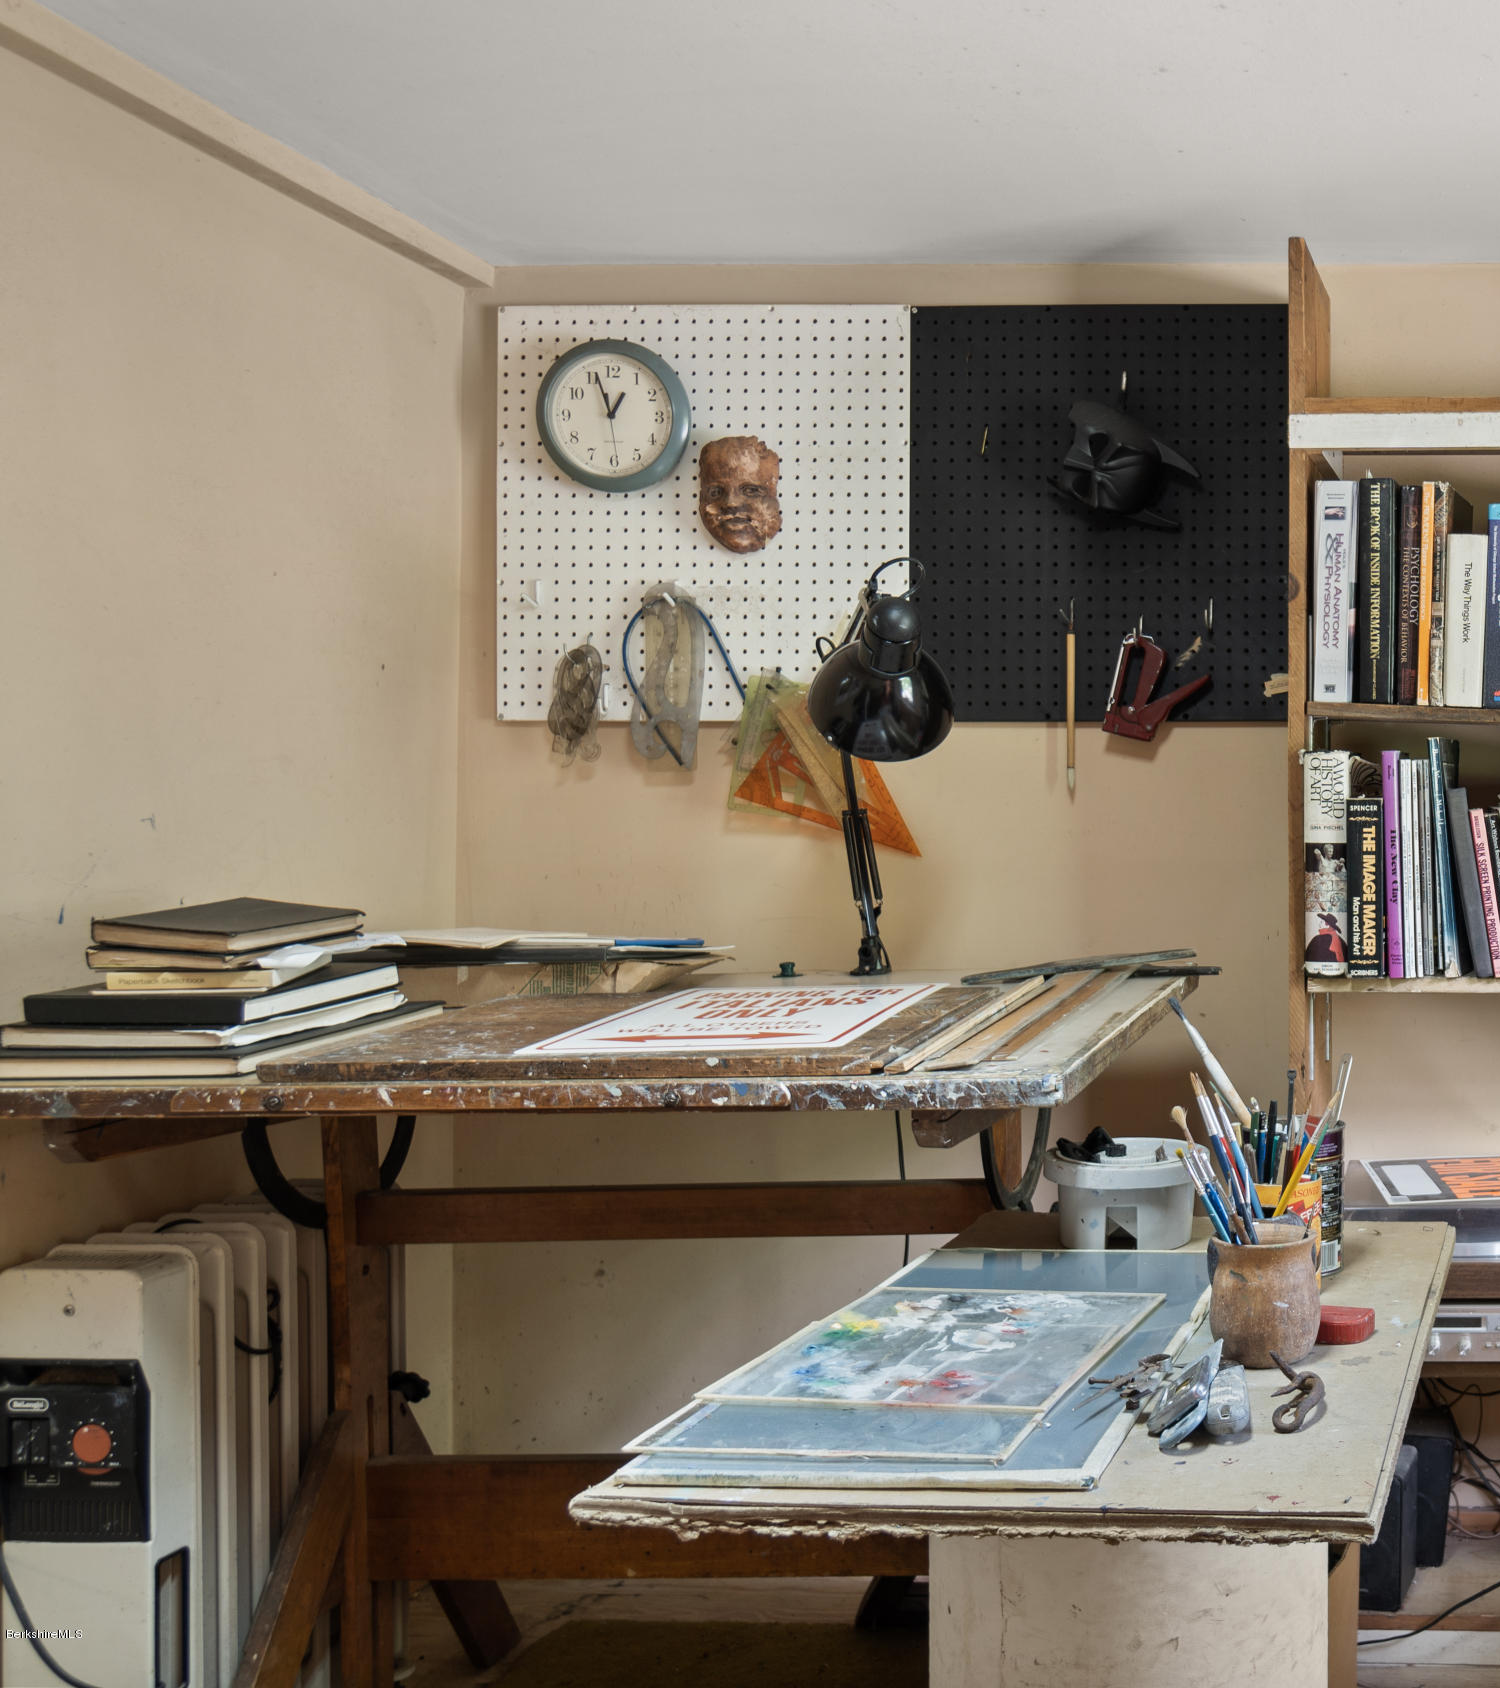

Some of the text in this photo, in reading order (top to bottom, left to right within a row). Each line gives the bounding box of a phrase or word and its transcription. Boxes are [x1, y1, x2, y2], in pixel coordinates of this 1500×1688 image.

[606, 365, 621, 379] 12
[633, 373, 640, 385] 1
[570, 387, 584, 400] 10
[647, 388, 657, 402] 2
[561, 409, 571, 422] 9
[655, 411, 665, 424] 3
[570, 431, 579, 444] 8
[648, 433, 657, 445] 4
[587, 448, 597, 461] 7
[610, 455, 619, 468] 6
[632, 449, 642, 462] 5
[1369, 482, 1380, 659] THE BOOK OF INSIDE INFORMATION
[1331, 533, 1344, 648] HUMAN ANATOMY
[1409, 547, 1419, 625] PSYCHOLOGY
[1322, 565, 1333, 648] PHYSIOLOGY
[1399, 547, 1410, 663] THE CONTEXTS OF BEHAVIOR
[1461, 563, 1471, 643] The Way Things Work
[1309, 757, 1321, 806] OF ART
[1320, 758, 1333, 818] HISTORY
[1332, 769, 1344, 819] WORLD
[1349, 804, 1378, 812] SPENCER
[1490, 829, 1499, 849] Without
[1389, 828, 1399, 905] The New Clay
[1361, 825, 1376, 956] THE IMAGE MAKER
[1475, 842, 1500, 960] SILK SCREEN PRINTING PRODUCTION
[1351, 896, 1360, 956] Man and his Art
[1350, 969, 1378, 977] SCRIBNERS
[117, 976, 205, 986] Paperback Sketchbook
[695, 988, 905, 999] PARKING FOR
[676, 997, 876, 1009] ITALIANS
[693, 1007, 814, 1019] ONLY
